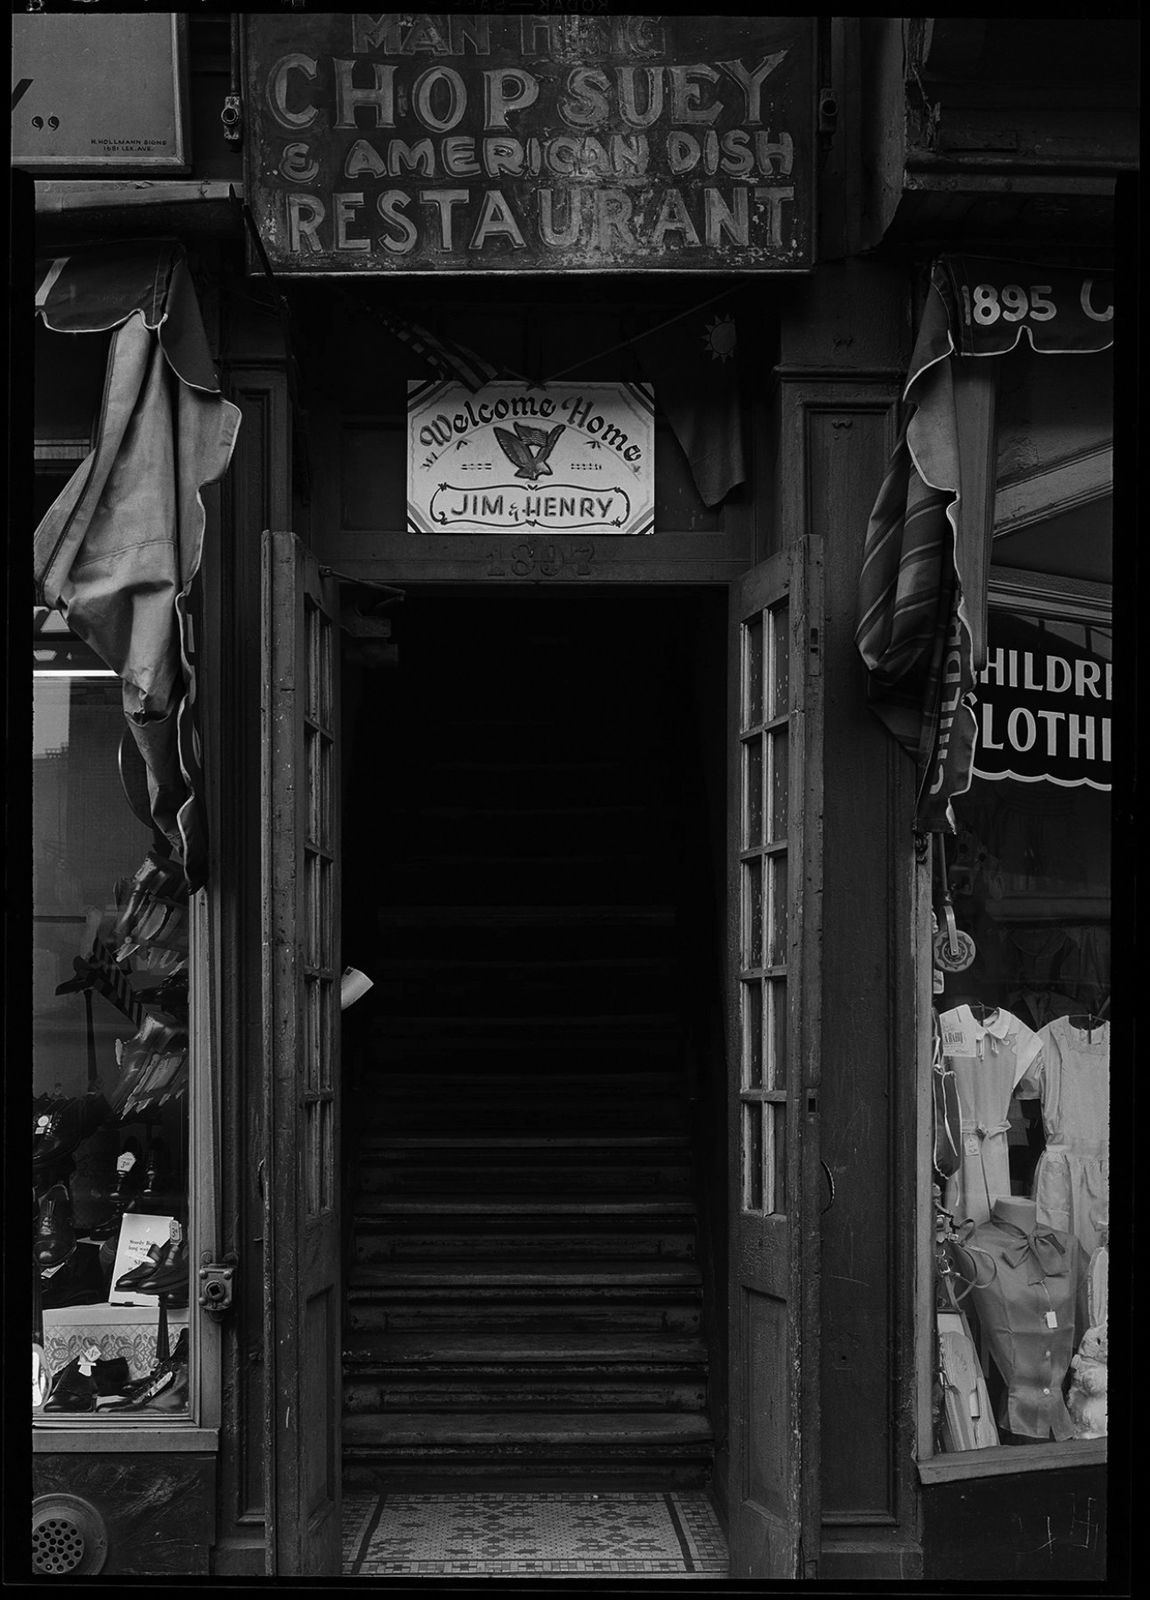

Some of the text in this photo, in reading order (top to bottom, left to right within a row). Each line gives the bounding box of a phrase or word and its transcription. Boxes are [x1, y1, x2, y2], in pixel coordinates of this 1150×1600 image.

[352, 14, 491, 56] MAN
[265, 49, 789, 132] CHOP SUEY
[344, 134, 650, 179] AMERICAN
[665, 129, 794, 176] DISH
[285, 186, 795, 255] RESTAURANT
[961, 283, 1058, 326] 1895
[419, 396, 642, 462] Welcome Home
[451, 494, 504, 516] JIM
[524, 496, 614, 518] HENRY
[965, 690, 1113, 762] LOTHI
